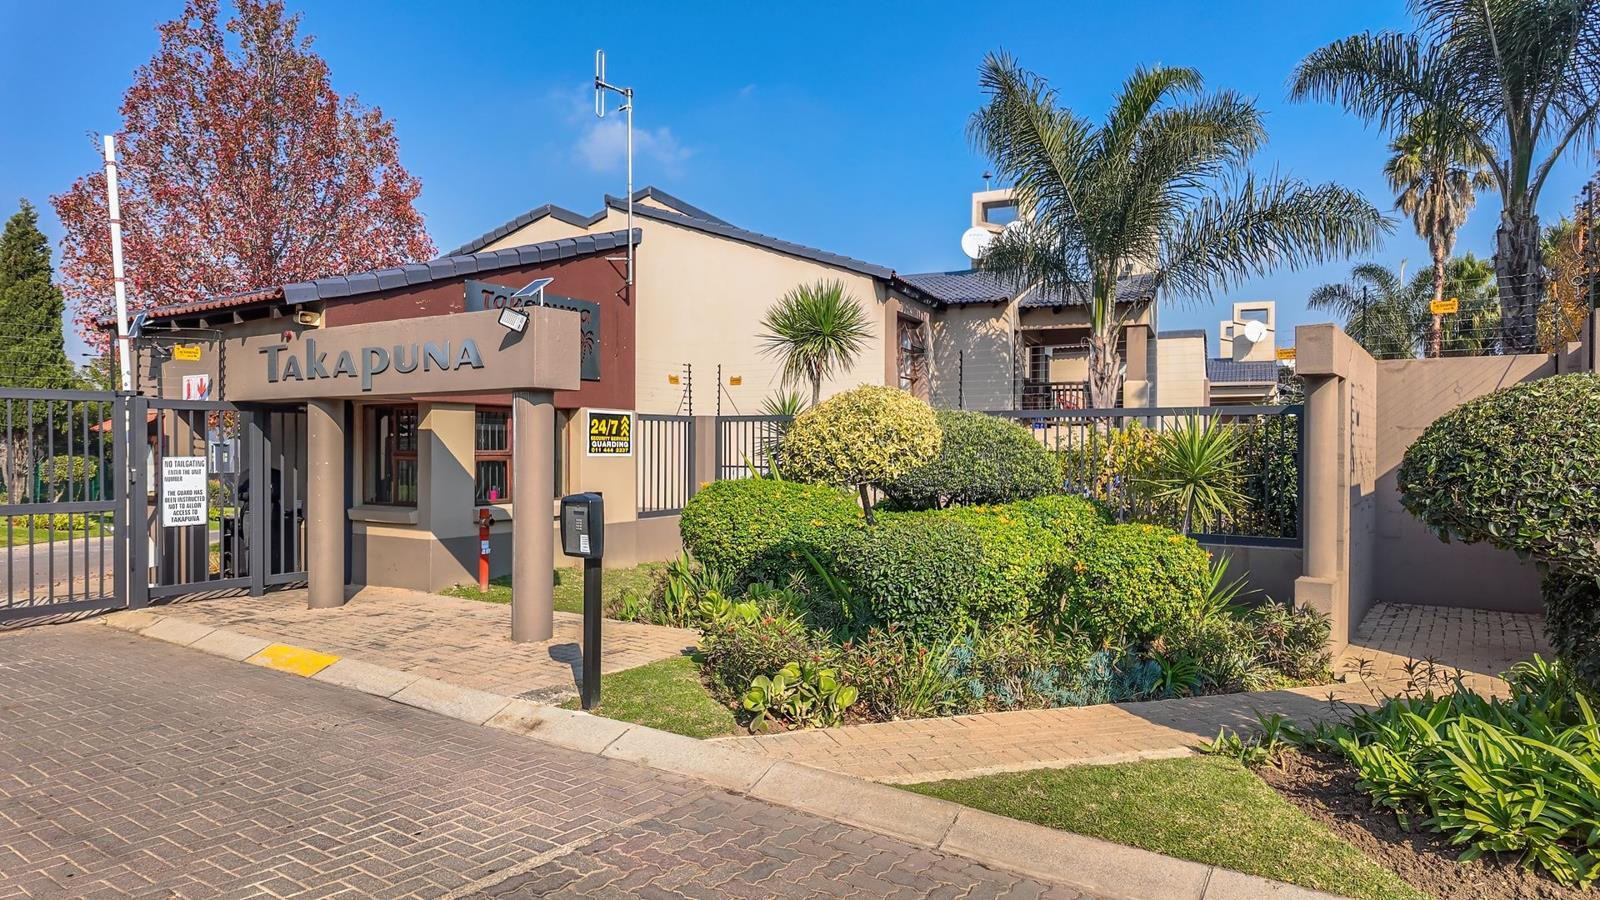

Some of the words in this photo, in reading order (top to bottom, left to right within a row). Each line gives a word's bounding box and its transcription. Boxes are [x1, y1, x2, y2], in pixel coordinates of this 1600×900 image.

[591, 418, 619, 436] 24/7
[164, 460, 173, 468] NO
[174, 460, 205, 468] TAILGATING
[171, 515, 200, 523] TAKAPUNA
